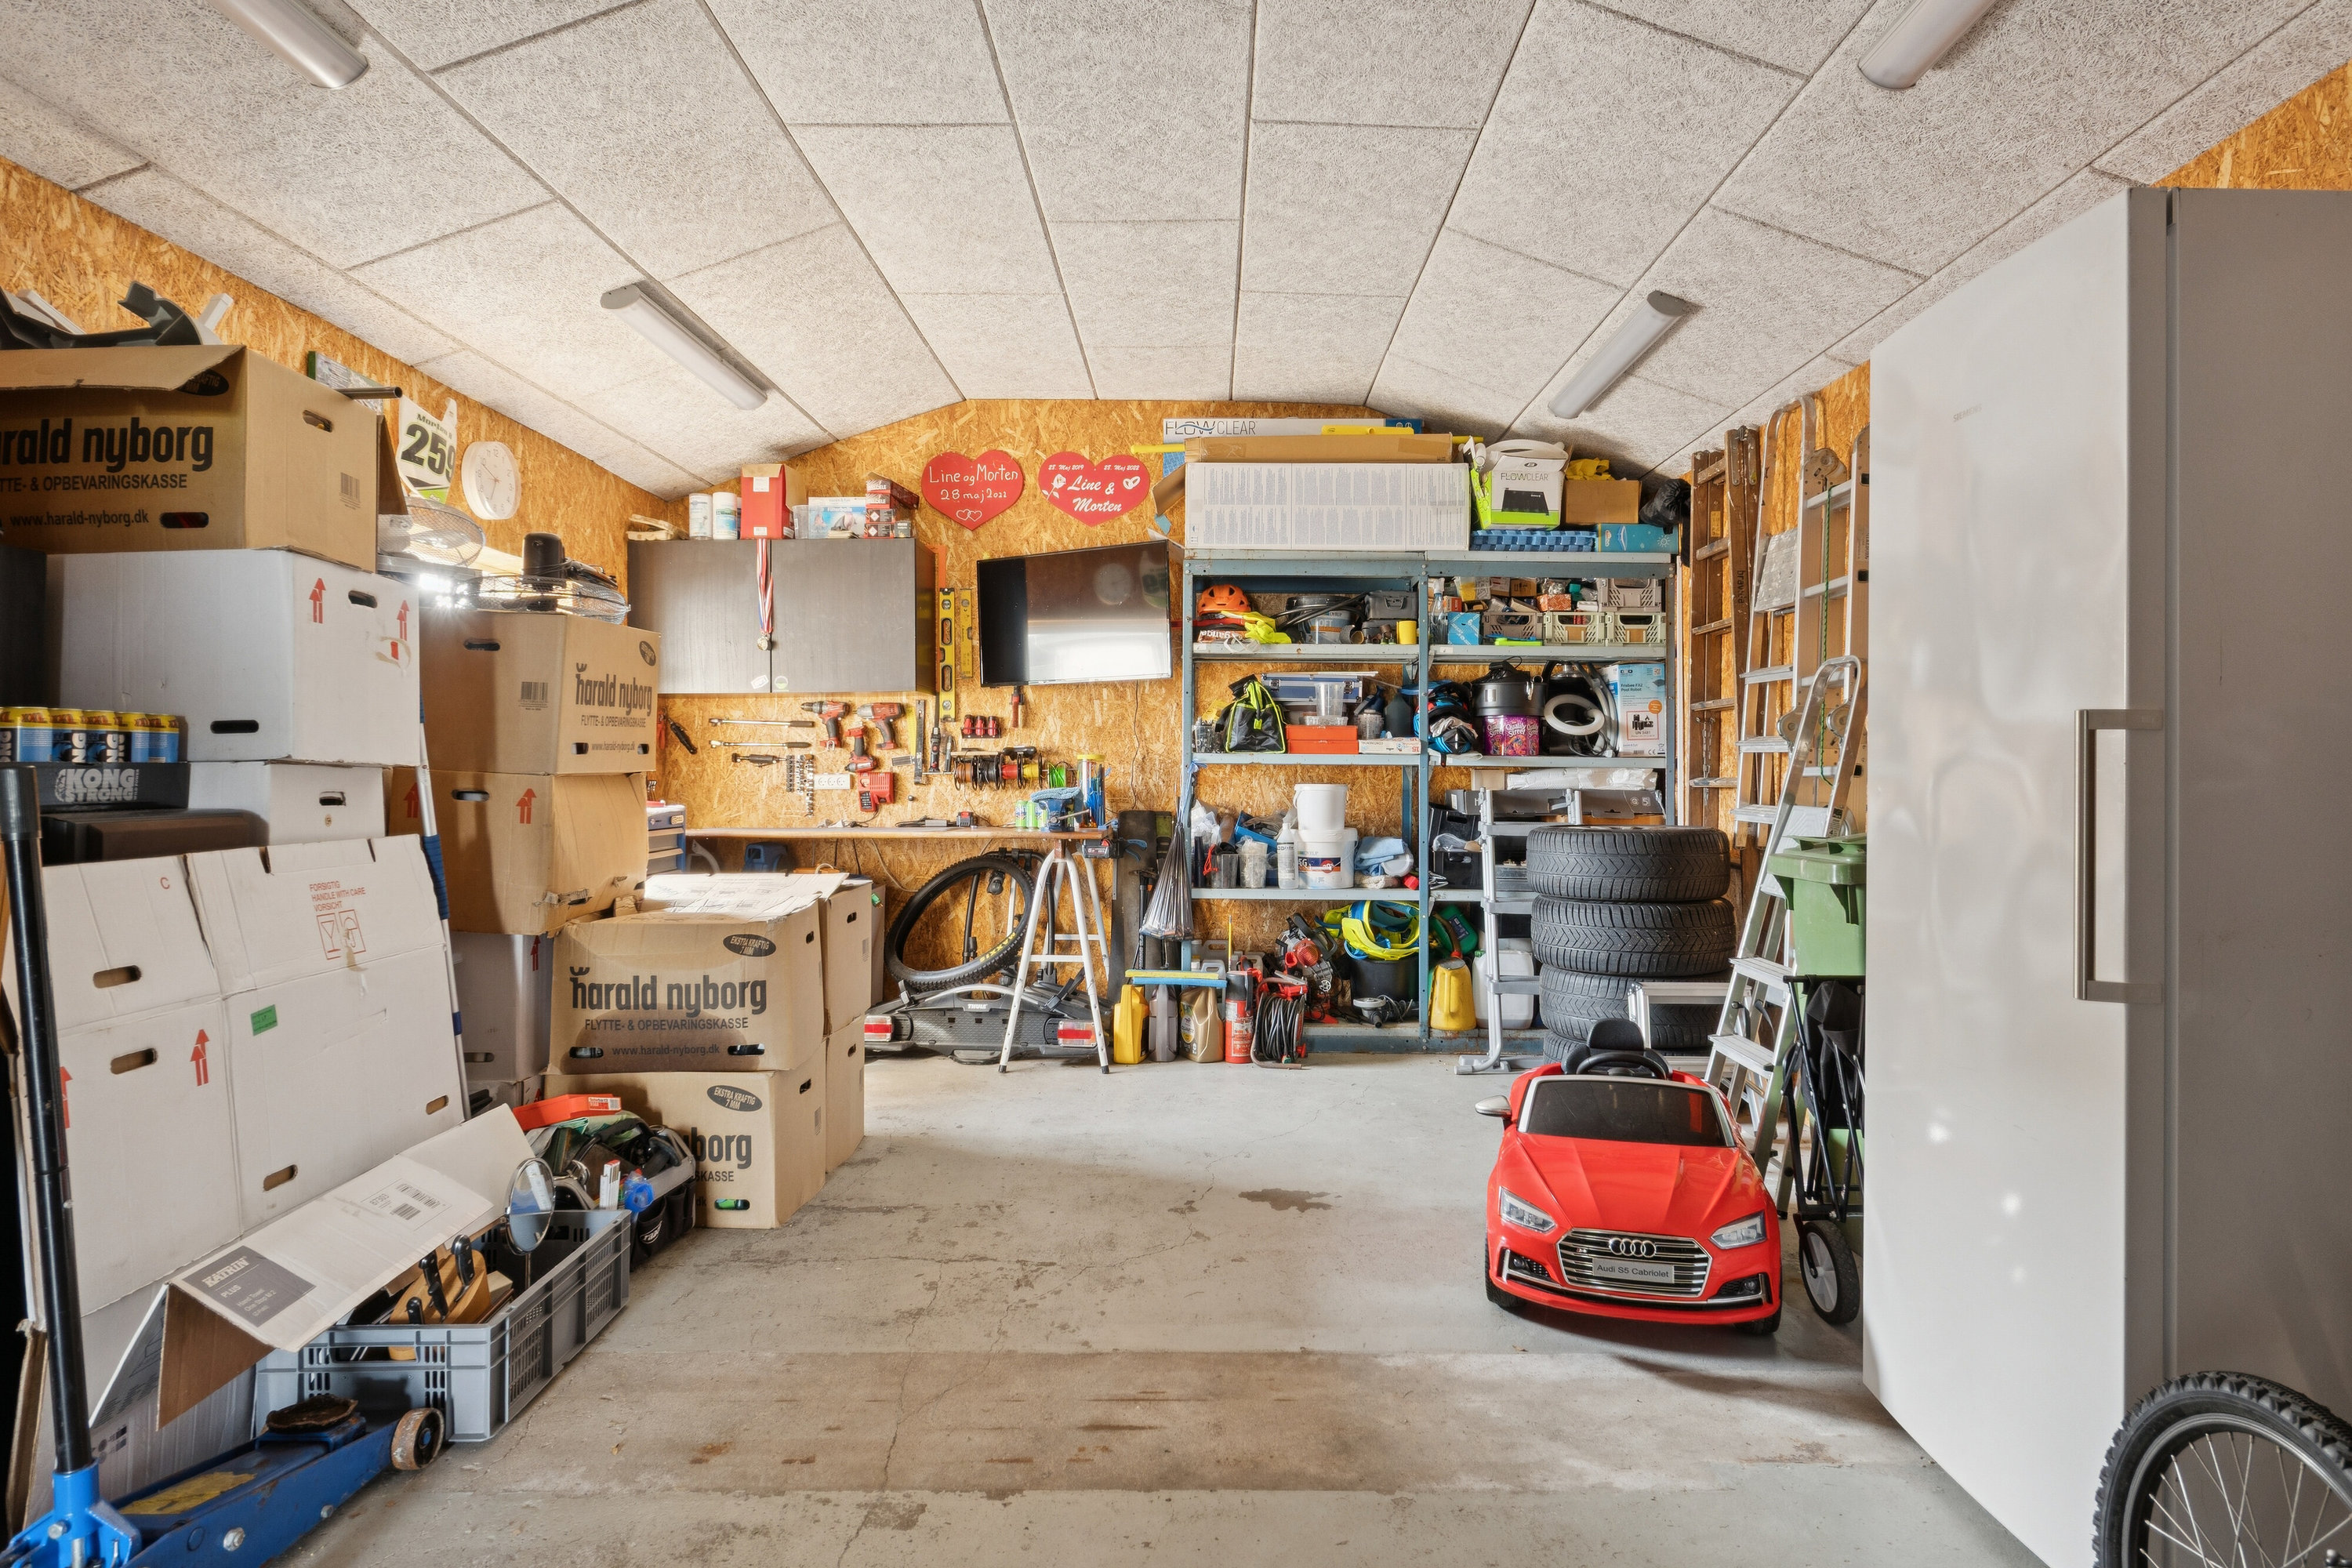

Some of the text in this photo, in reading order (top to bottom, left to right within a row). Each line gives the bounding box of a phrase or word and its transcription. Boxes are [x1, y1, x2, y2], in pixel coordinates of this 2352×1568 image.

[82, 417, 214, 473] nyborg
[401, 423, 456, 484] 259
[929, 463, 1018, 486] Line og Morten
[43, 474, 188, 492] OPBEVARINGSKASSE
[1067, 475, 1115, 495] Line &
[940, 488, 1007, 503] 28 maj 2022
[1073, 497, 1122, 512] Morten
[9, 509, 149, 528] www.harald-nyborg.dk
[575, 673, 652, 717] harald nyborg
[1506, 723, 1526, 731] Quality
[65, 768, 135, 789] KONG
[64, 786, 134, 803] STRONG
[160, 877, 170, 890] C
[309, 880, 340, 891] FORSIGTIG
[312, 892, 336, 902] HANDLE
[350, 887, 366, 896] CARE
[314, 901, 343, 912] VORSICHT
[748, 938, 770, 950] KRAFTIG
[979, 932, 1017, 964] MAXXIS
[570, 975, 768, 1018] harald nyborg
[585, 1017, 749, 1031] FLYTTE- & OPBEVARINGSKASSE
[612, 1044, 720, 1057] www.harald-nyborg.dk
[713, 1087, 756, 1105] EKSTRA KRAFTIG
[725, 1098, 741, 1109] 7 MM
[202, 1258, 250, 1288] KATRIN
[1597, 1265, 1615, 1273] Audi
[1632, 1268, 1670, 1278] Cabriolet
[221, 1284, 241, 1298] PLUS
